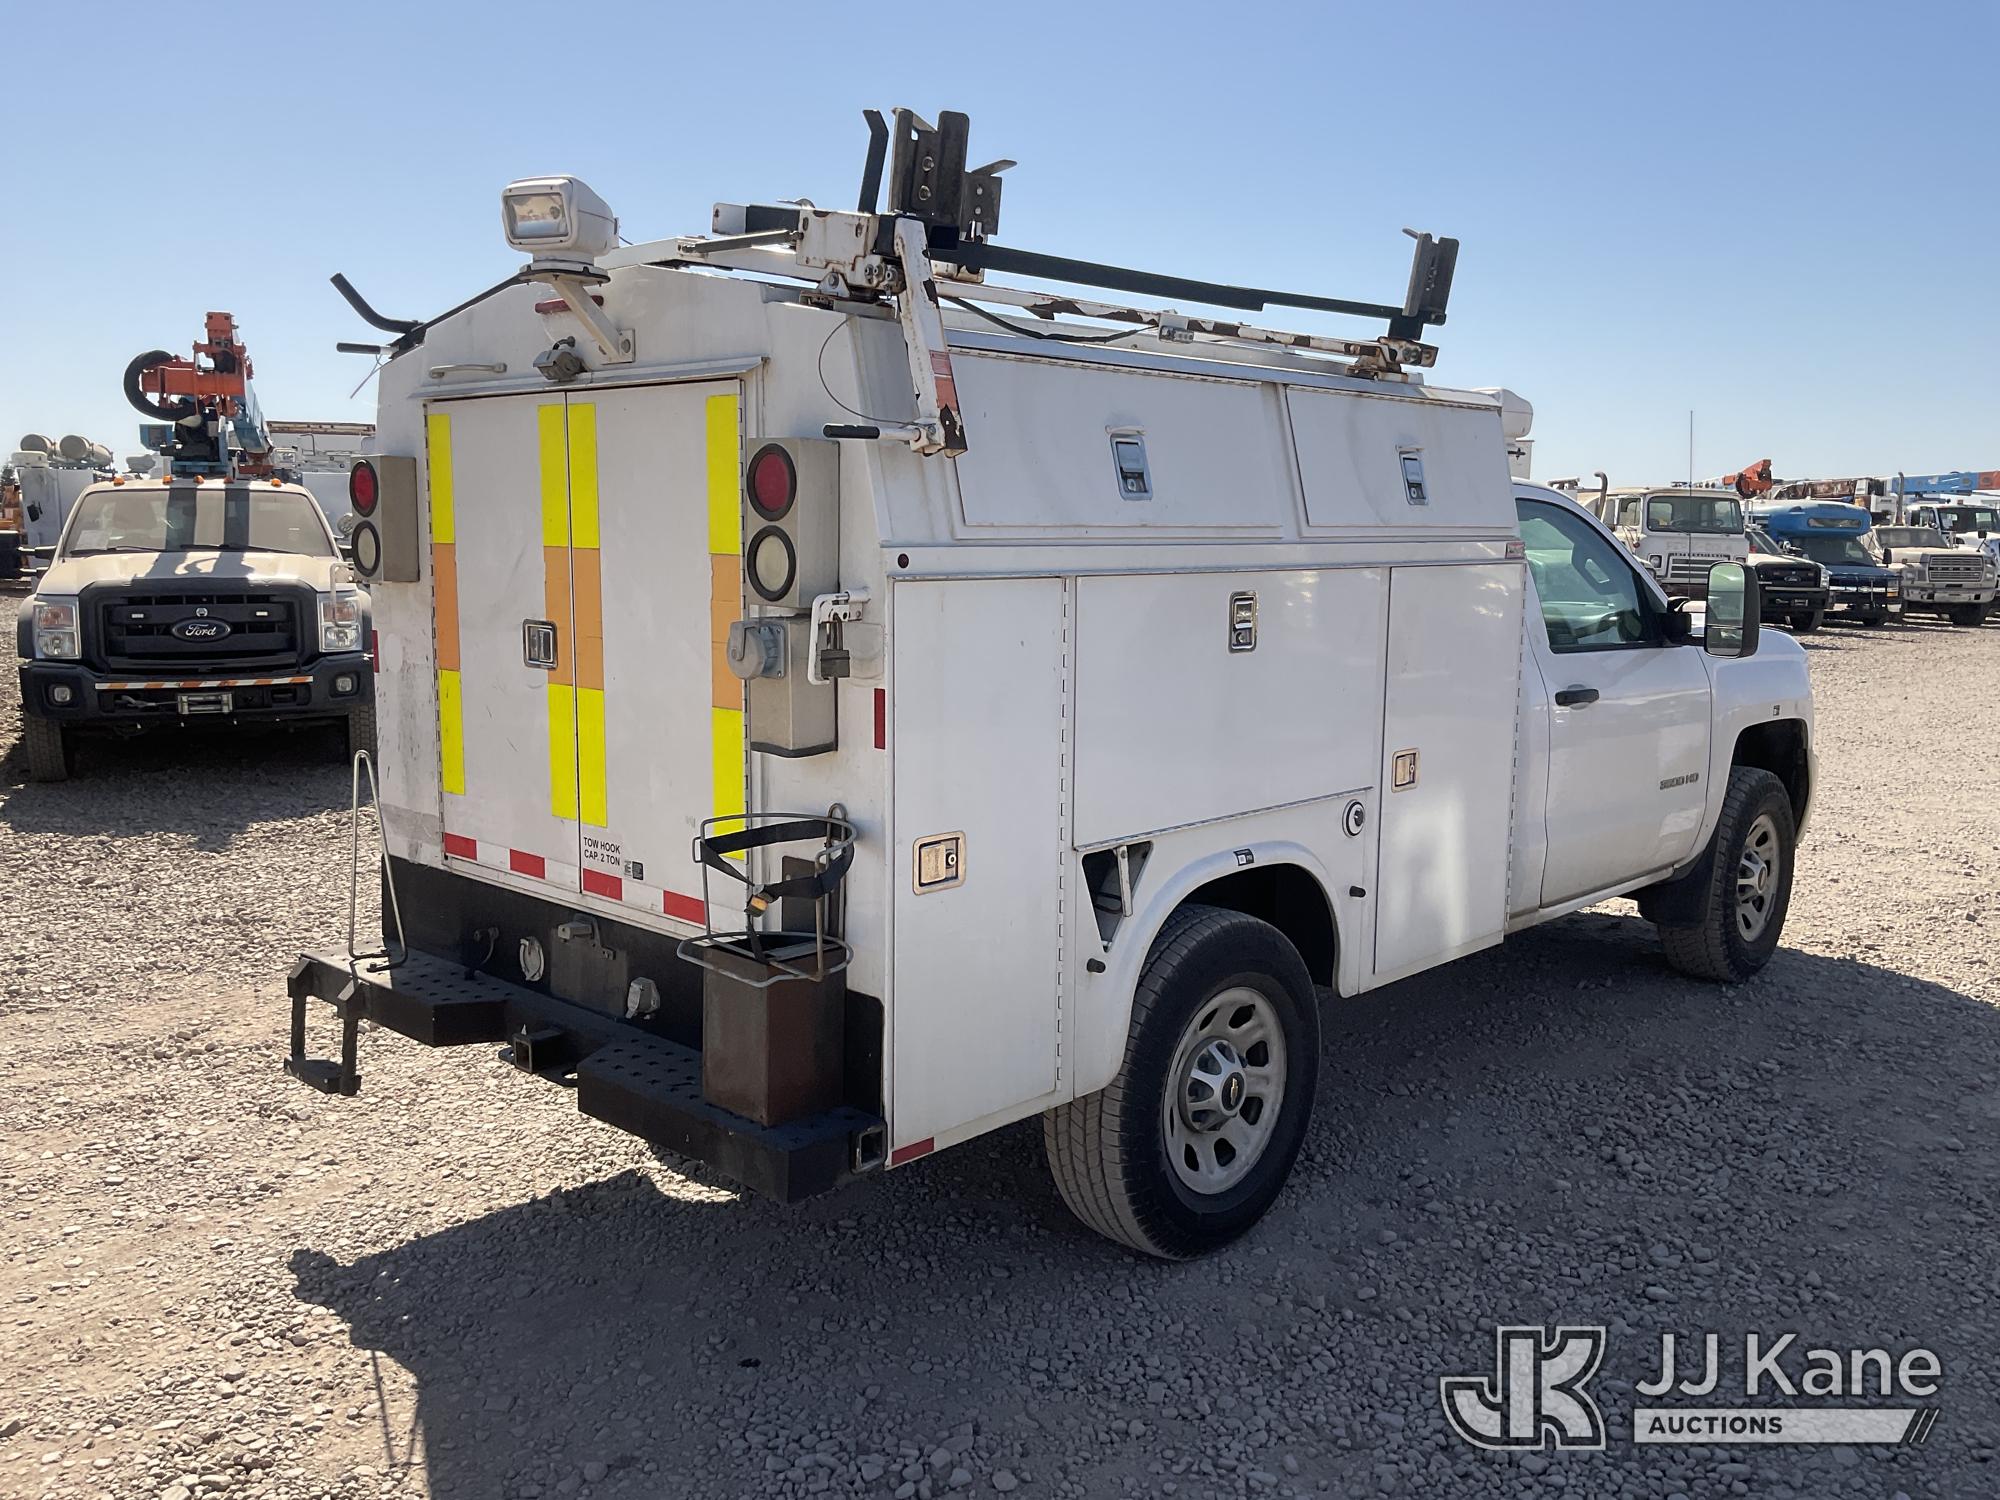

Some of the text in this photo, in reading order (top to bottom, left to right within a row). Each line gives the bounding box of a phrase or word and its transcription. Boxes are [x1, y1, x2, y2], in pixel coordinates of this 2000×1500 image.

[185, 623, 216, 636] Ford
[583, 837, 621, 854] TOW HOOK
[584, 849, 621, 866] CAP. 2 TON
